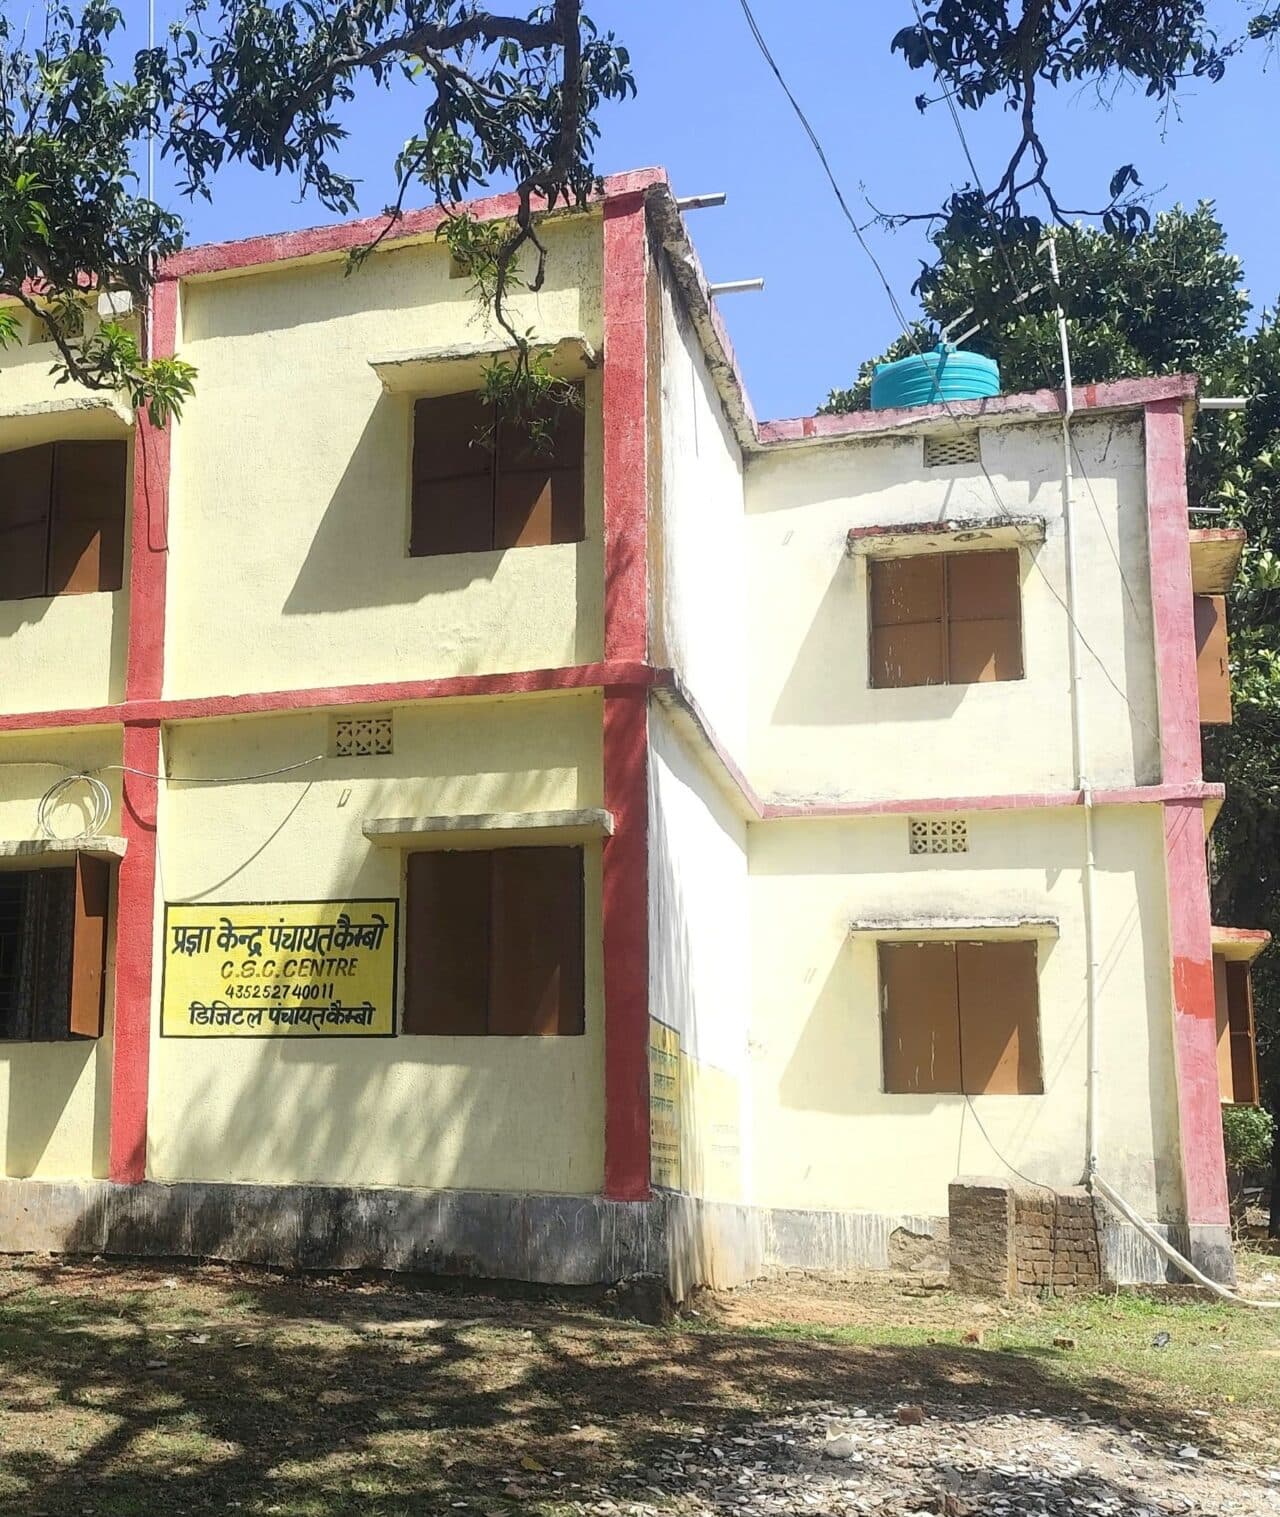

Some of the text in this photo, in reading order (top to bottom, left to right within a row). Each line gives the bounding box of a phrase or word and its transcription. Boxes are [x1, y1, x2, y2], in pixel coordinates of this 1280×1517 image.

[171, 925, 216, 957] प्रज्ञा
[217, 917, 266, 957] केन्द्र
[225, 983, 334, 1000] 435252740011
[189, 1001, 268, 1029] डिजिटल
